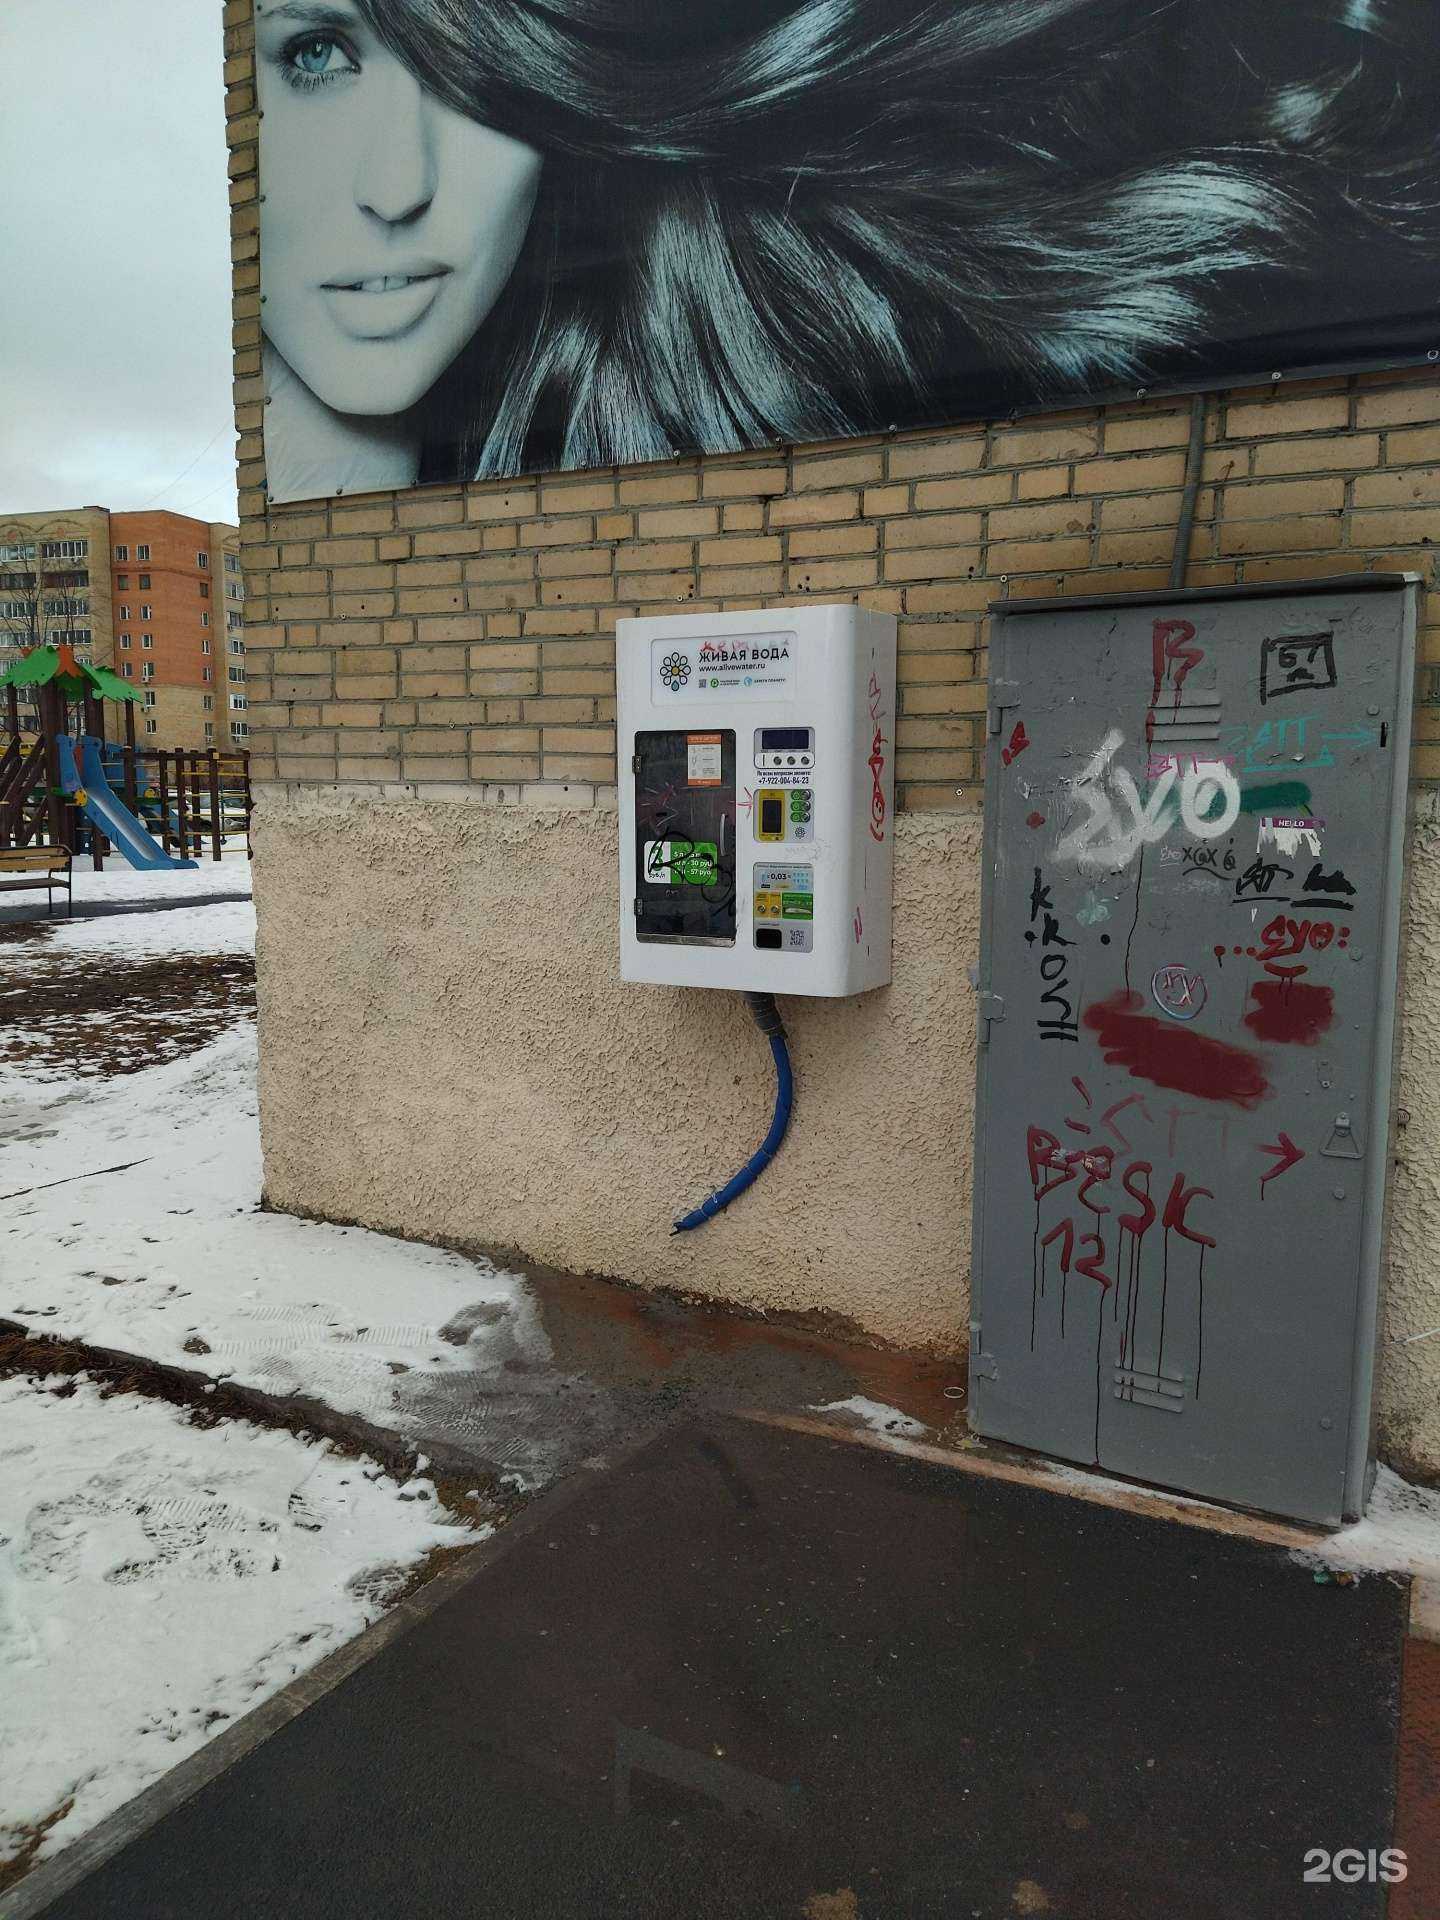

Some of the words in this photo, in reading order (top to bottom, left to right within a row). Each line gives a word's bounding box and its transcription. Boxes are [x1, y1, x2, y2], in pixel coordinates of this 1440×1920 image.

[699, 650, 746, 663] ЖИВАЯ
[752, 648, 789, 661] ВОДА
[699, 663, 766, 673] www.alivewater.ru
